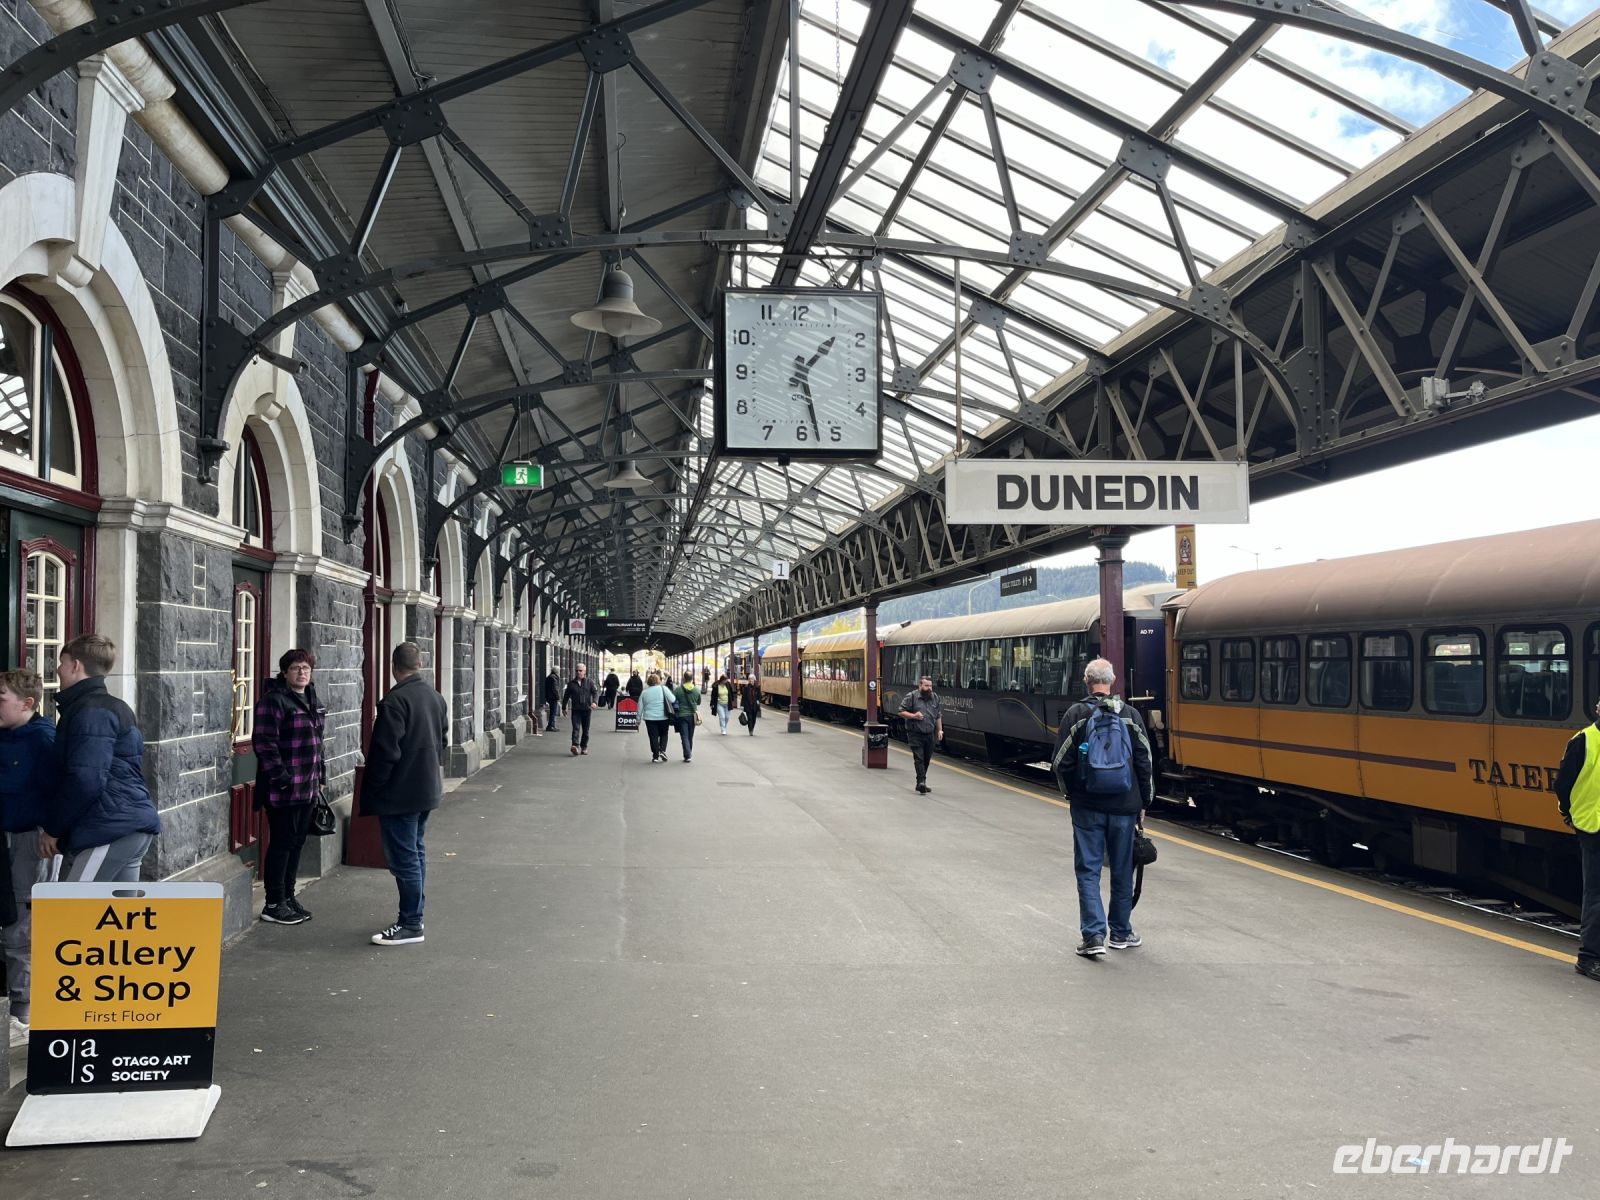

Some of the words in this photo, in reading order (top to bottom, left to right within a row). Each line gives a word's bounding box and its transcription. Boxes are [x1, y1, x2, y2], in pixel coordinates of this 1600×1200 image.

[761, 304, 772, 320] 11
[793, 306, 809, 320] 12
[733, 329, 750, 345] 10
[855, 332, 866, 348] 2
[736, 364, 748, 380] 9
[855, 367, 866, 383] 3
[736, 400, 748, 415] 8
[856, 402, 867, 417] 4
[762, 425, 774, 441] 7
[796, 426, 808, 441] 6
[830, 426, 842, 442] 5
[997, 474, 1199, 511] DUNEDIN
[777, 563, 784, 577] 1
[617, 717, 637, 725] Open
[95, 905, 157, 930] Art
[54, 939, 196, 973] Gallery
[54, 975, 82, 1002] &
[94, 975, 192, 1008] Shop
[84, 1010, 117, 1023] First
[122, 1010, 162, 1023] Floor
[112, 1056, 160, 1067] OTAGO
[163, 1055, 191, 1066] ART
[111, 1070, 170, 1081] SOCIETY
